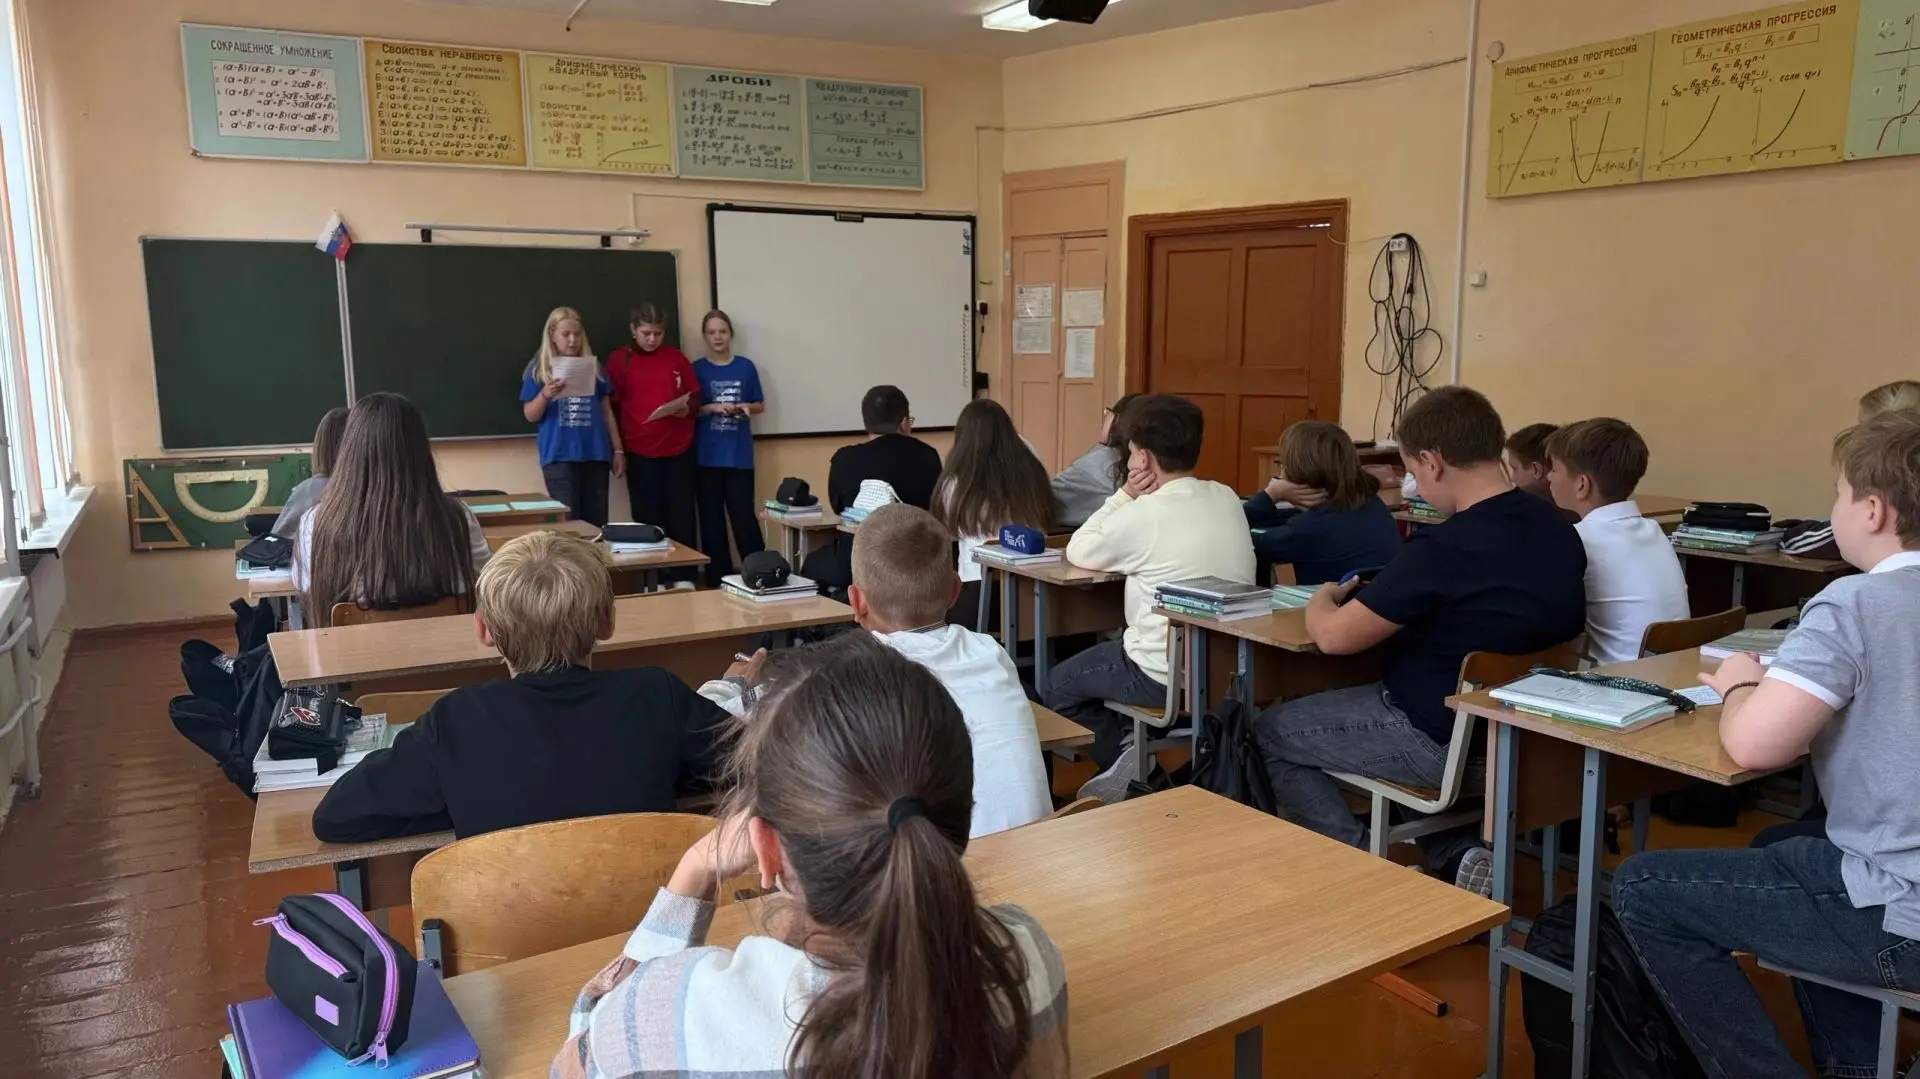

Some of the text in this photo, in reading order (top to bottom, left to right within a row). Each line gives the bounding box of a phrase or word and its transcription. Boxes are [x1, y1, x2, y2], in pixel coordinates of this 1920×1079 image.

[1671, 4, 1837, 45] ГЕОМЕТРИЧЕСКАЯ ПРОГРЕССИЯ
[210, 39, 334, 59] СОКРАЩЕННОЕ УМНОЖЕНИЕ
[382, 44, 503, 62] СВОЙСТВА НЕРАВЕНСТВ
[555, 58, 641, 73] АРИФМЕТИЧЕСКИЙ
[1504, 44, 1637, 77] АРИФМЕТИЧЕСКАЯ ПРОГРЕССИЯ
[548, 66, 647, 81] КВАДРАТНЫЙ КОРЕНЬ
[706, 74, 772, 87] ДРОБИ
